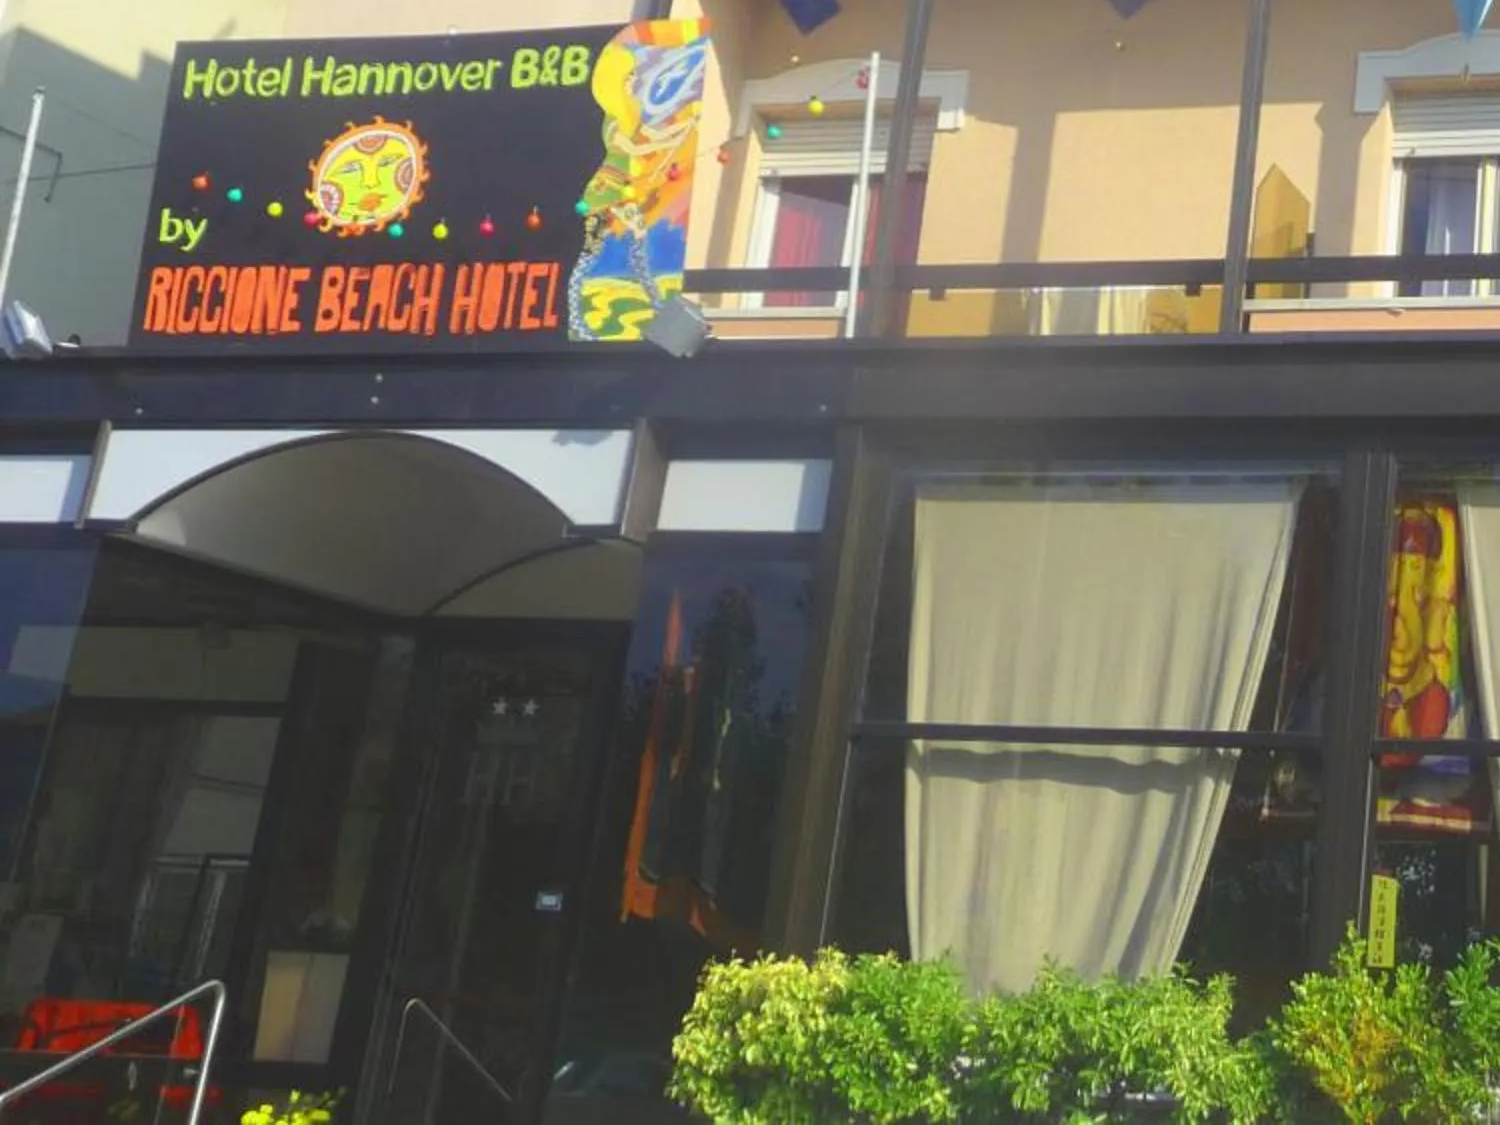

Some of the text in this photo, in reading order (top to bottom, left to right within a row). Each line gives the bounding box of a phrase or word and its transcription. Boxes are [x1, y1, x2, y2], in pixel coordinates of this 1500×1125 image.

[182, 44, 590, 100] Hotel Hannover B&B
[159, 207, 208, 252] by
[143, 261, 561, 336] RICCIONE BEACH HOTEL
